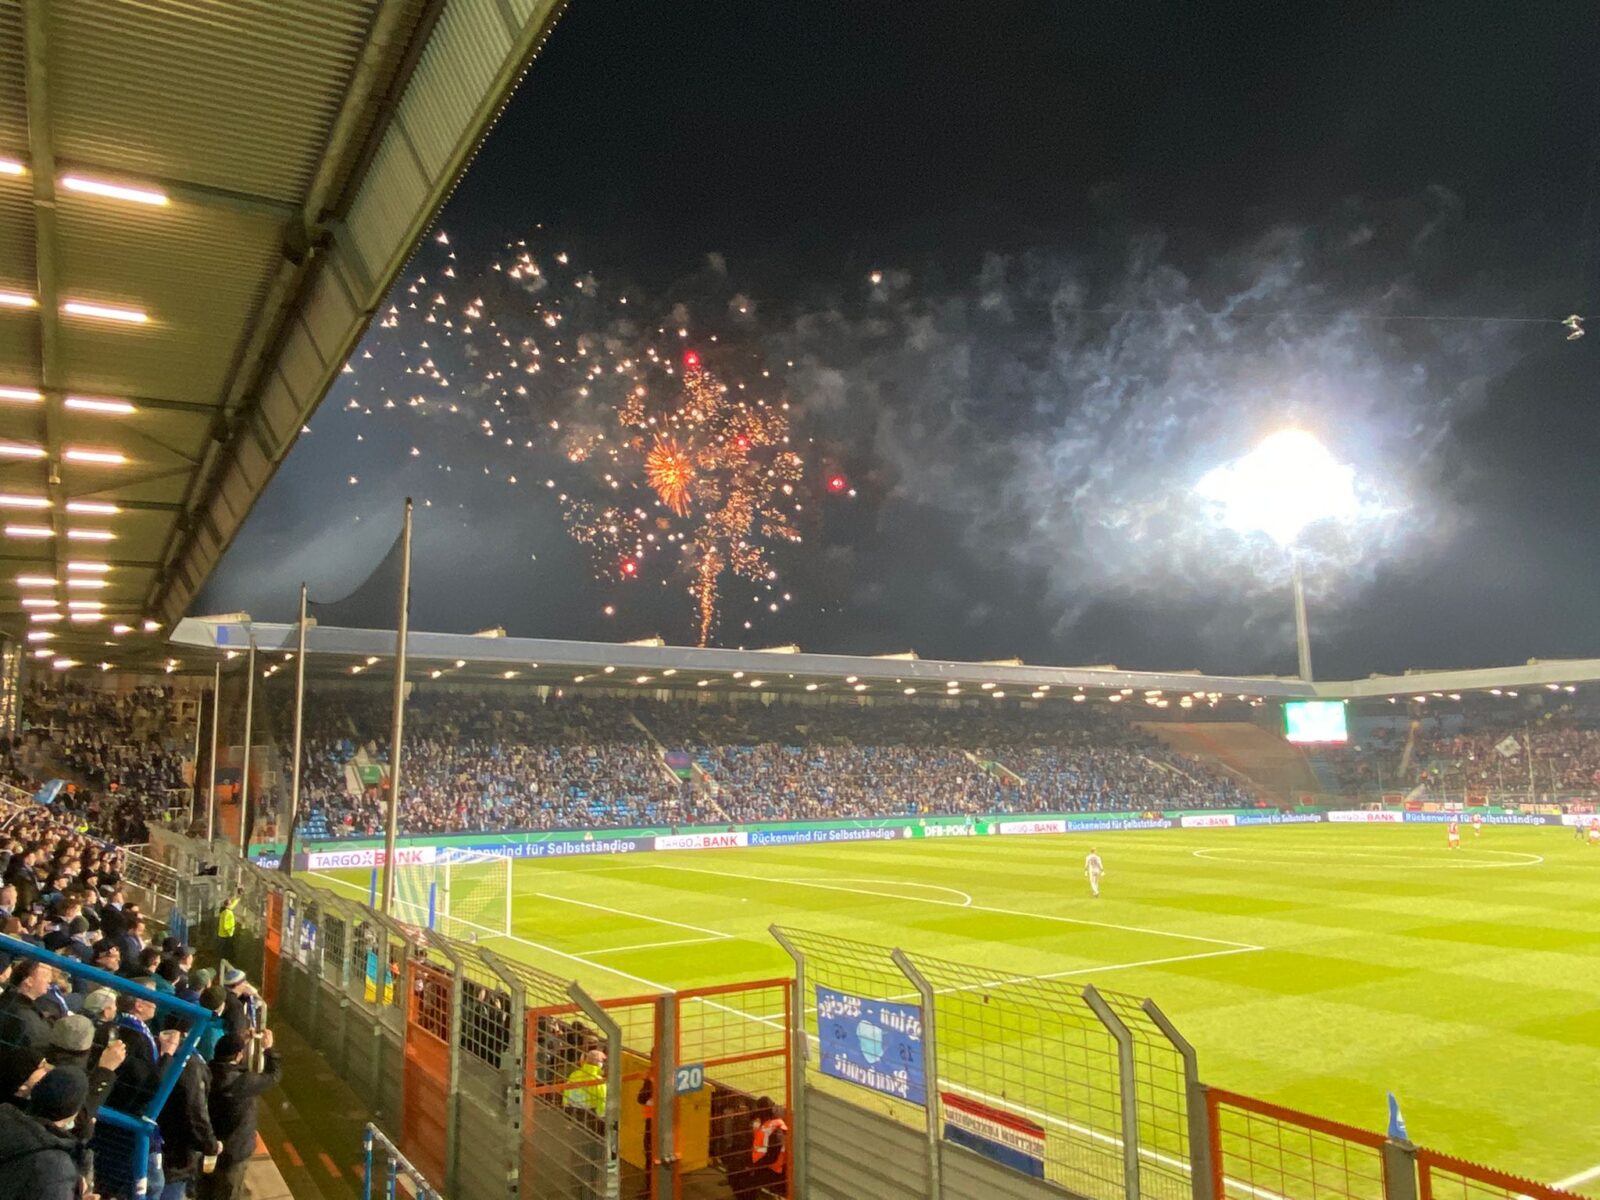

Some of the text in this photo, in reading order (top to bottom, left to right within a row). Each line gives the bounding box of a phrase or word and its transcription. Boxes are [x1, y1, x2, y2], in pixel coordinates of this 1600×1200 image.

[752, 827, 895, 844] Rückenwind für Selbstständige
[526, 843, 544, 856] für
[547, 839, 636, 855] Selbstständige
[678, 1068, 702, 1091] 20
